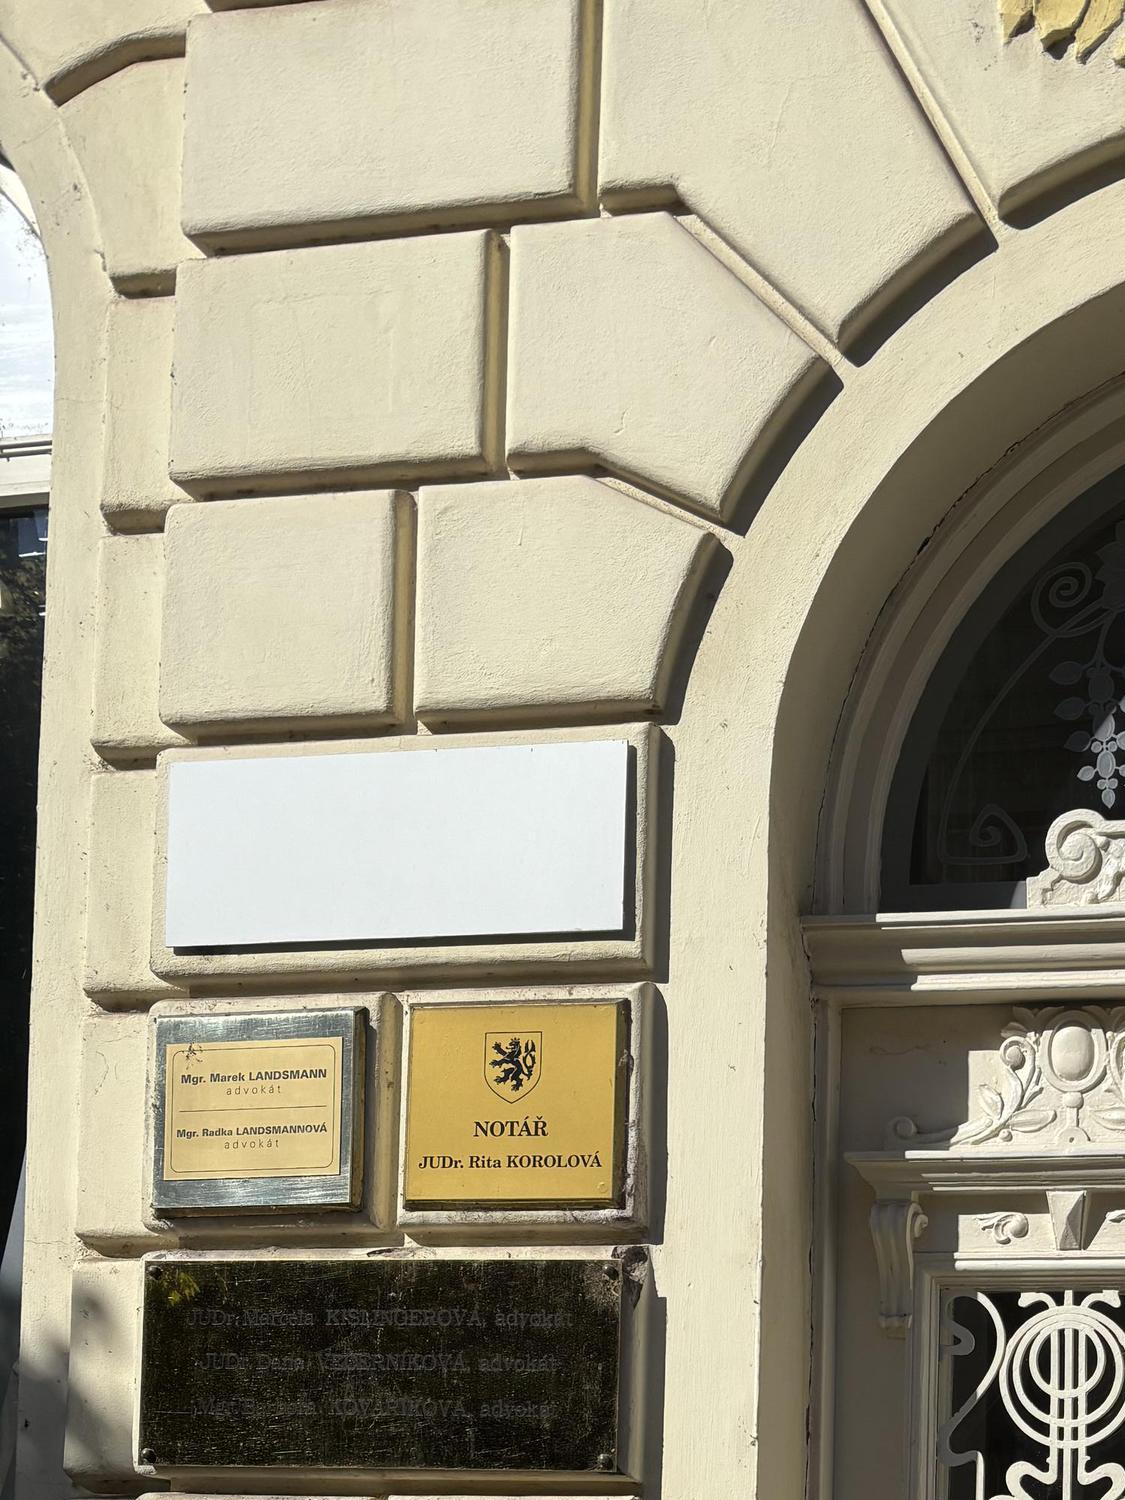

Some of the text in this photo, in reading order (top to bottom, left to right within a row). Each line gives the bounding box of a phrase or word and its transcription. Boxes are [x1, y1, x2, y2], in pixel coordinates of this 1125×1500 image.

[181, 1069, 326, 1085] Mgr. Marek LANDSMANN
[226, 1085, 280, 1095] advokát
[177, 1122, 327, 1139] Mgr. Radka LANDSMANNOVÁ
[474, 1116, 548, 1137] NOTÁŘ
[225, 1139, 278, 1149] advokát
[419, 1151, 602, 1169] JUDr. Rita KOROLOVÁ
